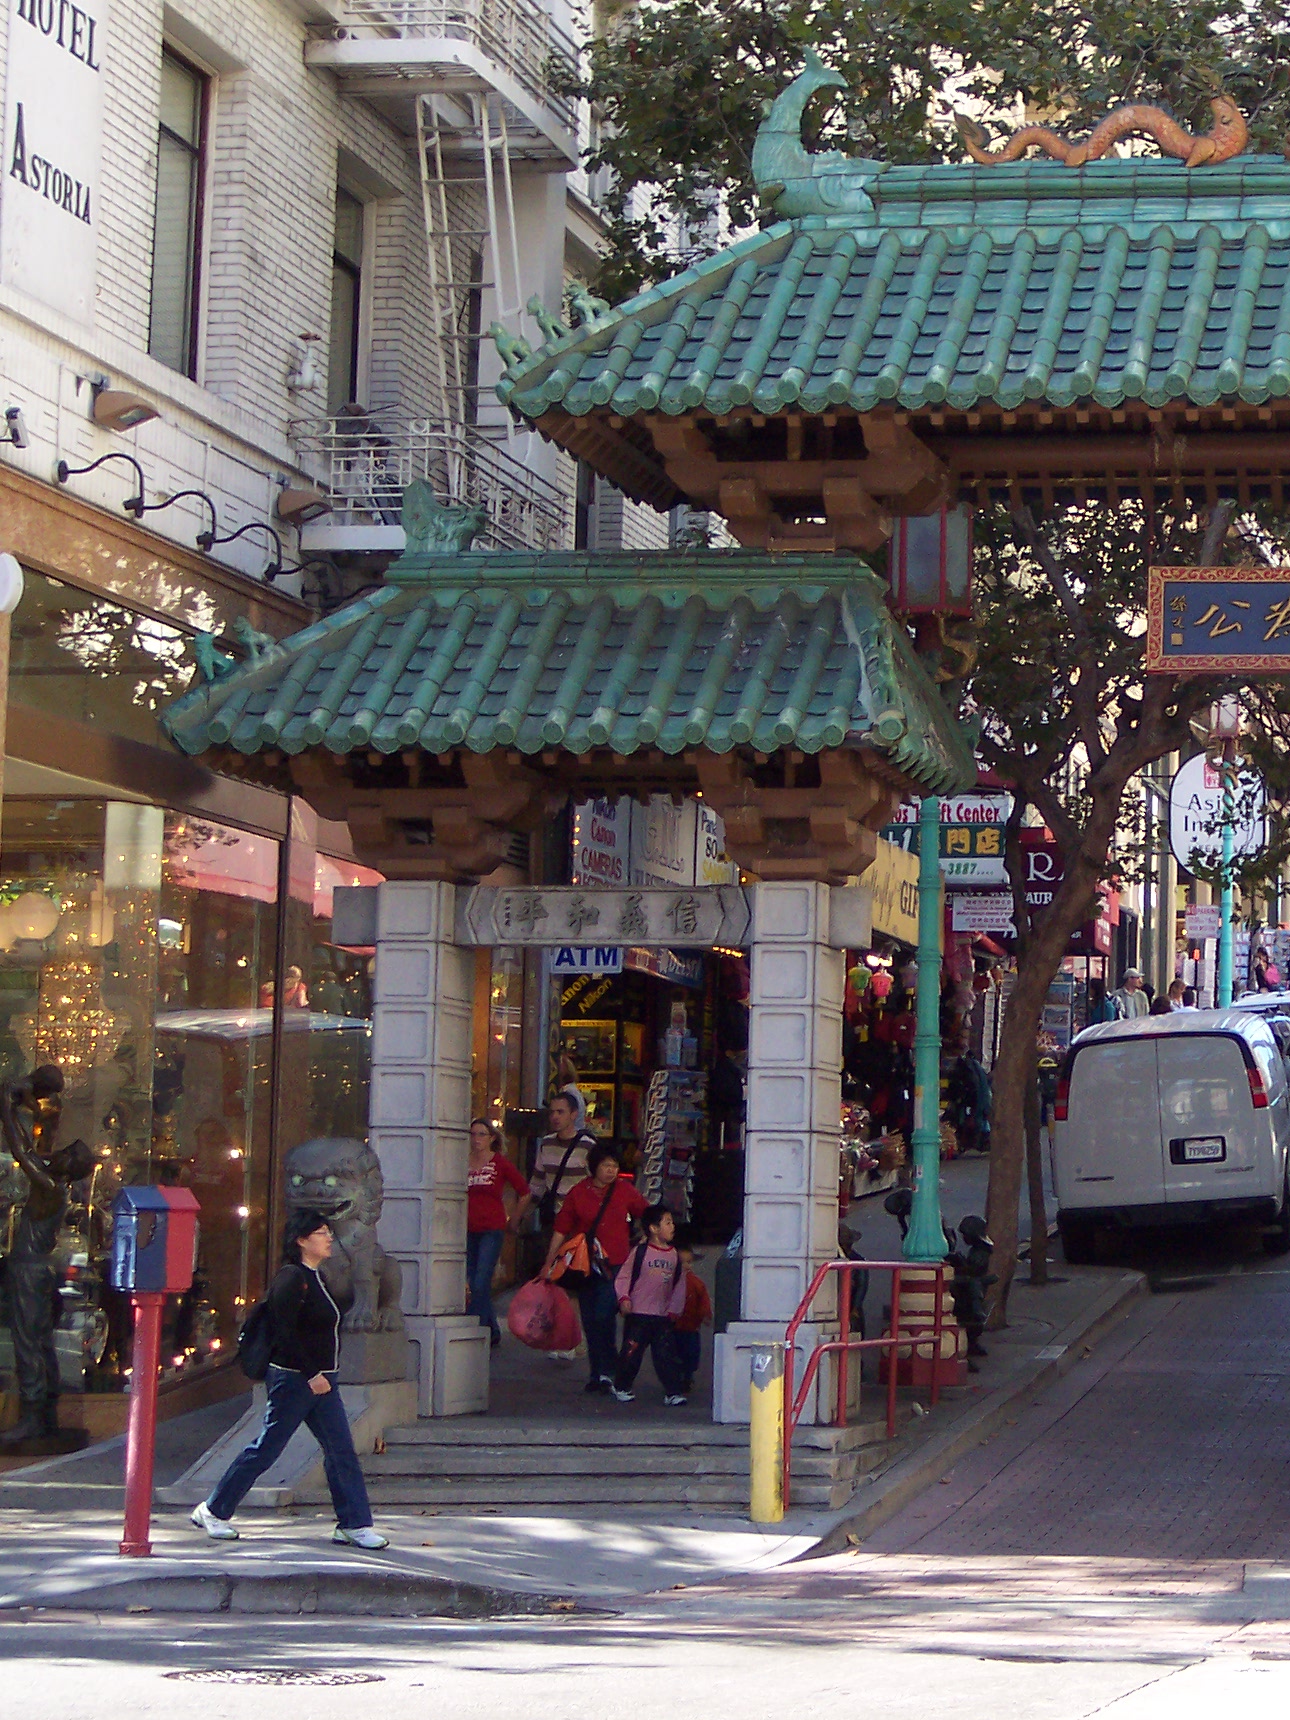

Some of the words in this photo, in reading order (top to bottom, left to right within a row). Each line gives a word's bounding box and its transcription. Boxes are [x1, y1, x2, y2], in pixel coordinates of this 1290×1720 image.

[9, 101, 92, 226] ASTORIA
[956, 802, 1000, 823] Center
[555, 947, 618, 967] ATM
[577, 977, 613, 1014] Nikon
